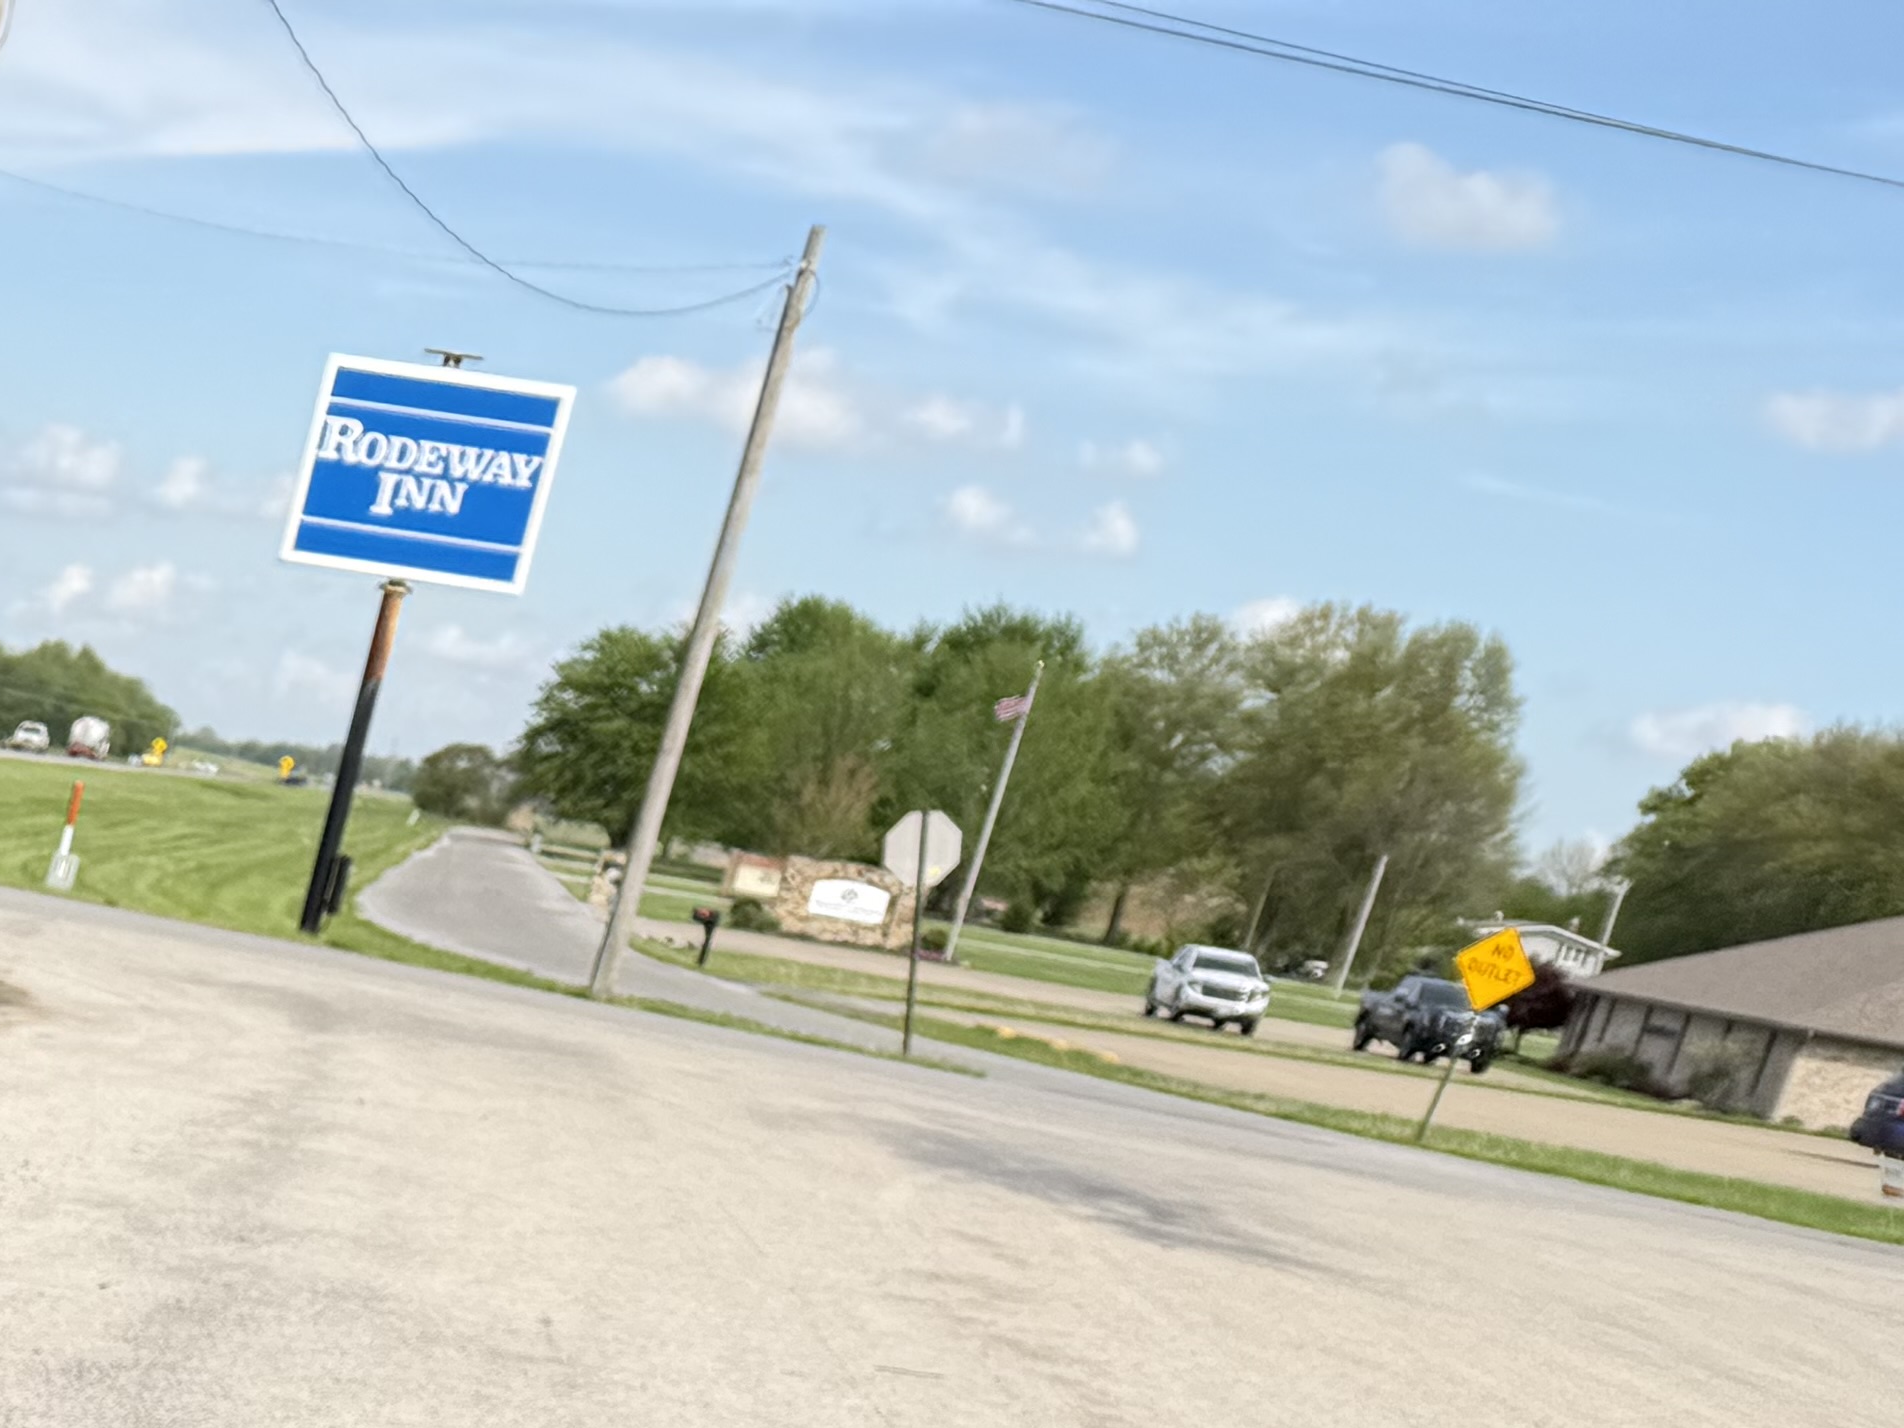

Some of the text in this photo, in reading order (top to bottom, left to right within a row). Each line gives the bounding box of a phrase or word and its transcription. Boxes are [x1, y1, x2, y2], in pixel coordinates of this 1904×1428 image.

[318, 414, 543, 488] RODEWAY
[368, 470, 469, 516] INN
[1467, 956, 1523, 986] OUTLET
[1492, 943, 1515, 962] NO
